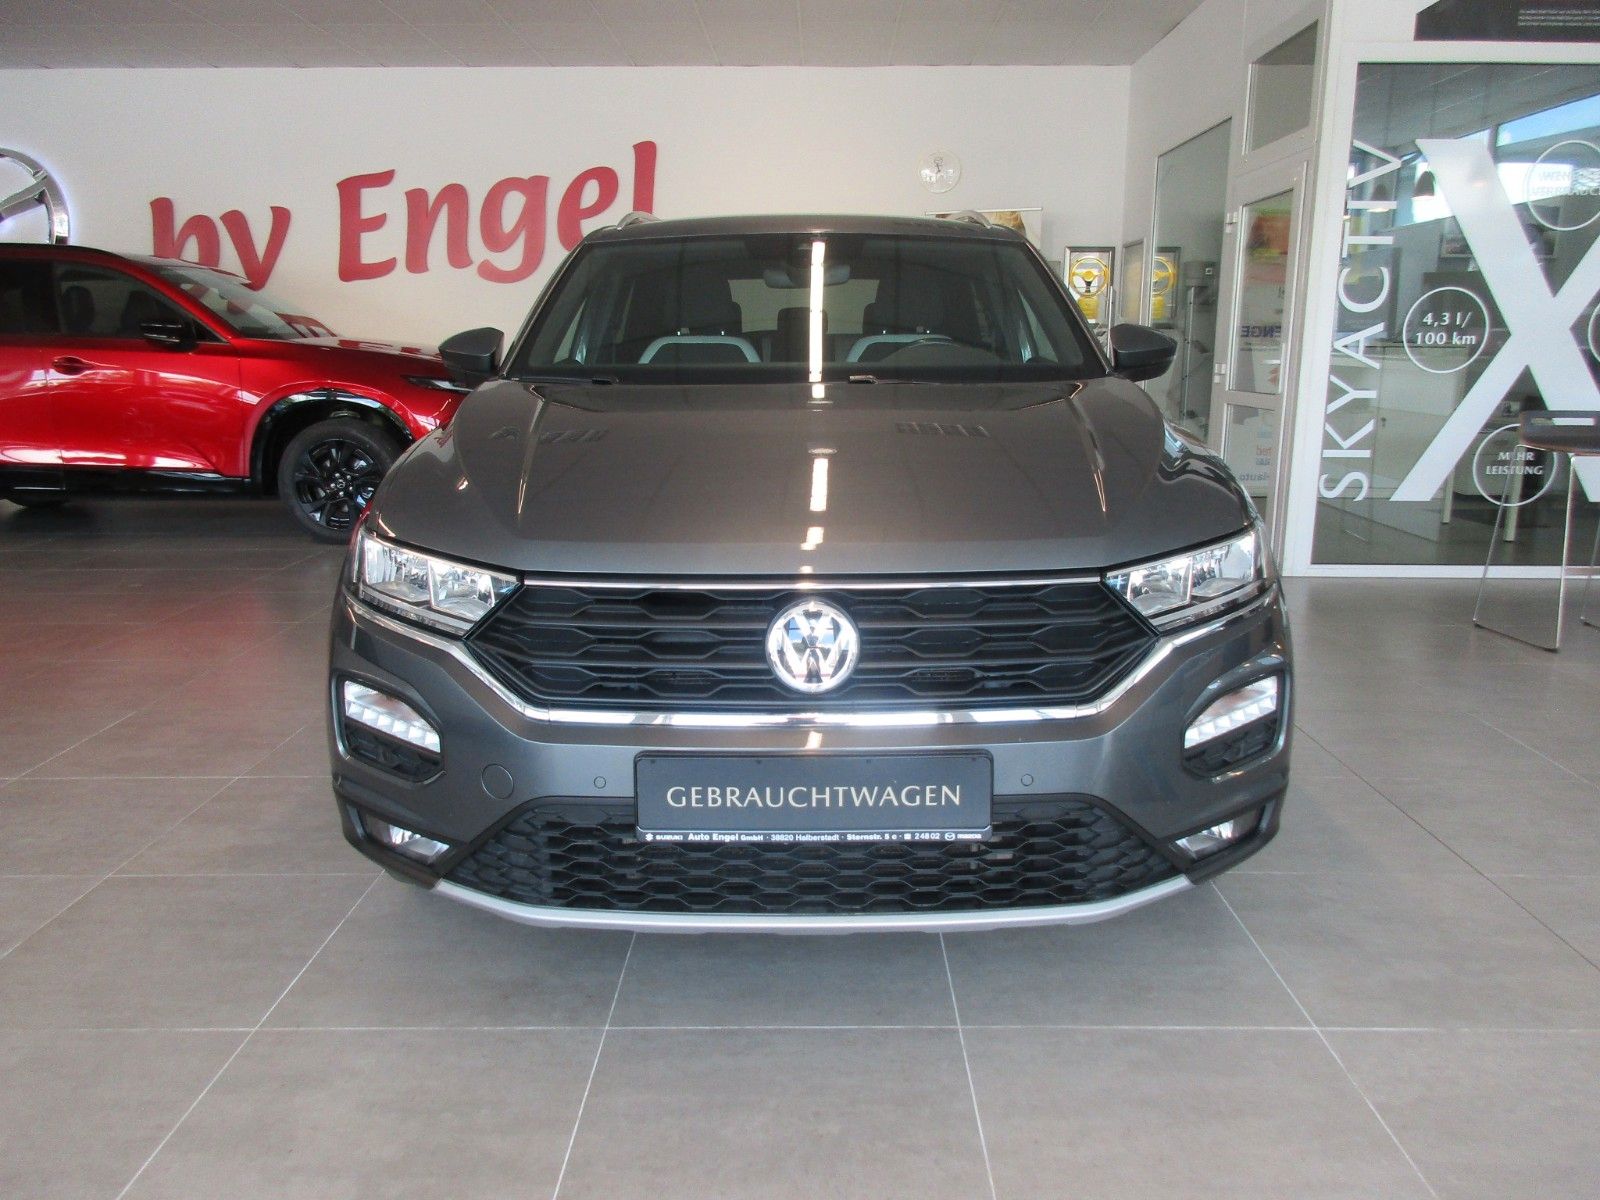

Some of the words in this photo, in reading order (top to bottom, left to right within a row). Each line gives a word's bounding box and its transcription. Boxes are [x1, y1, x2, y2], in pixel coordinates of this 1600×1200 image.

[336, 141, 656, 283] Engel
[1319, 139, 1402, 502] SKYACTIV
[1422, 312, 1450, 327] 4,3
[1415, 332, 1446, 345] 100
[1452, 331, 1476, 345] km
[1497, 451, 1535, 461] MHR
[666, 784, 961, 808] GEBRAUCHTWAGEN
[688, 832, 710, 841] Auto
[712, 832, 739, 843] Engel
[741, 833, 764, 841] GmbH
